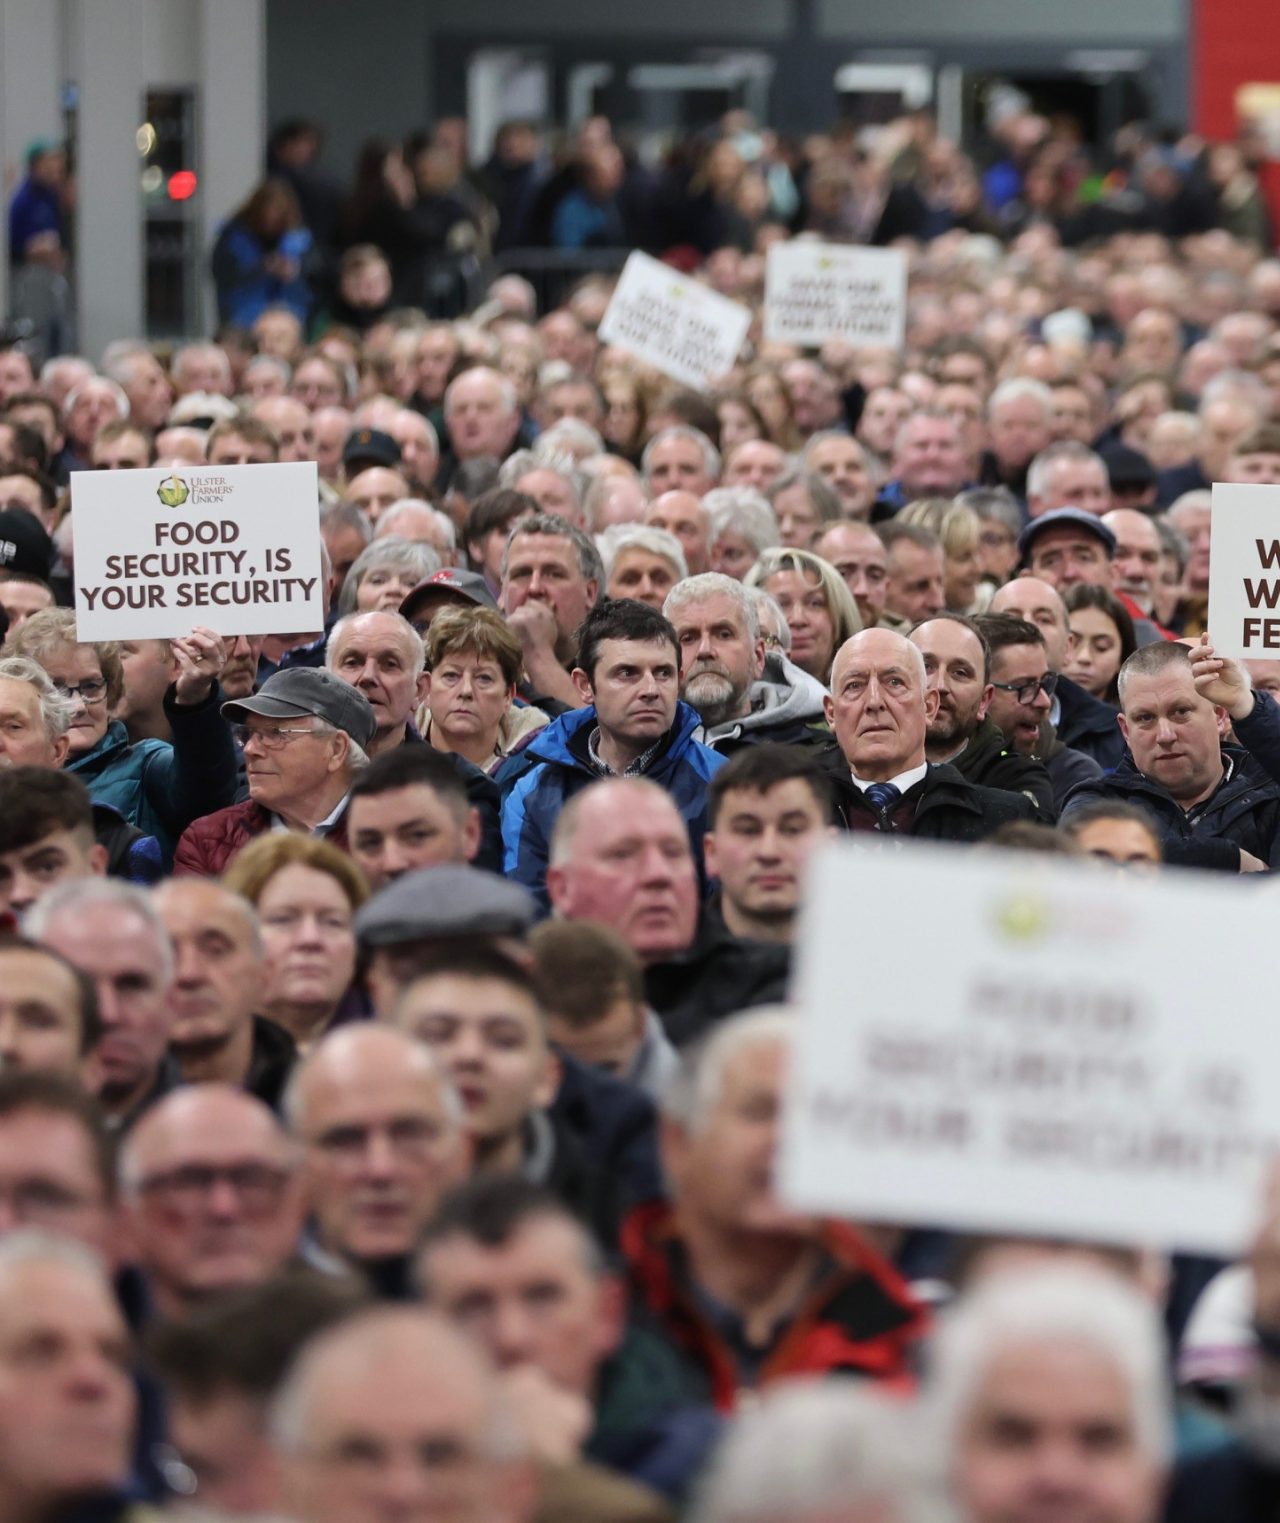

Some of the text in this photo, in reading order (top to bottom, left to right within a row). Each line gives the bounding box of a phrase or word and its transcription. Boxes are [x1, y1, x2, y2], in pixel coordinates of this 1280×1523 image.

[191, 477, 226, 487] ULSTER
[192, 495, 224, 504] UNION
[155, 520, 240, 546] FOOD
[105, 548, 292, 580] SECURITY, IS
[80, 577, 317, 611] YOUR SECURITY
